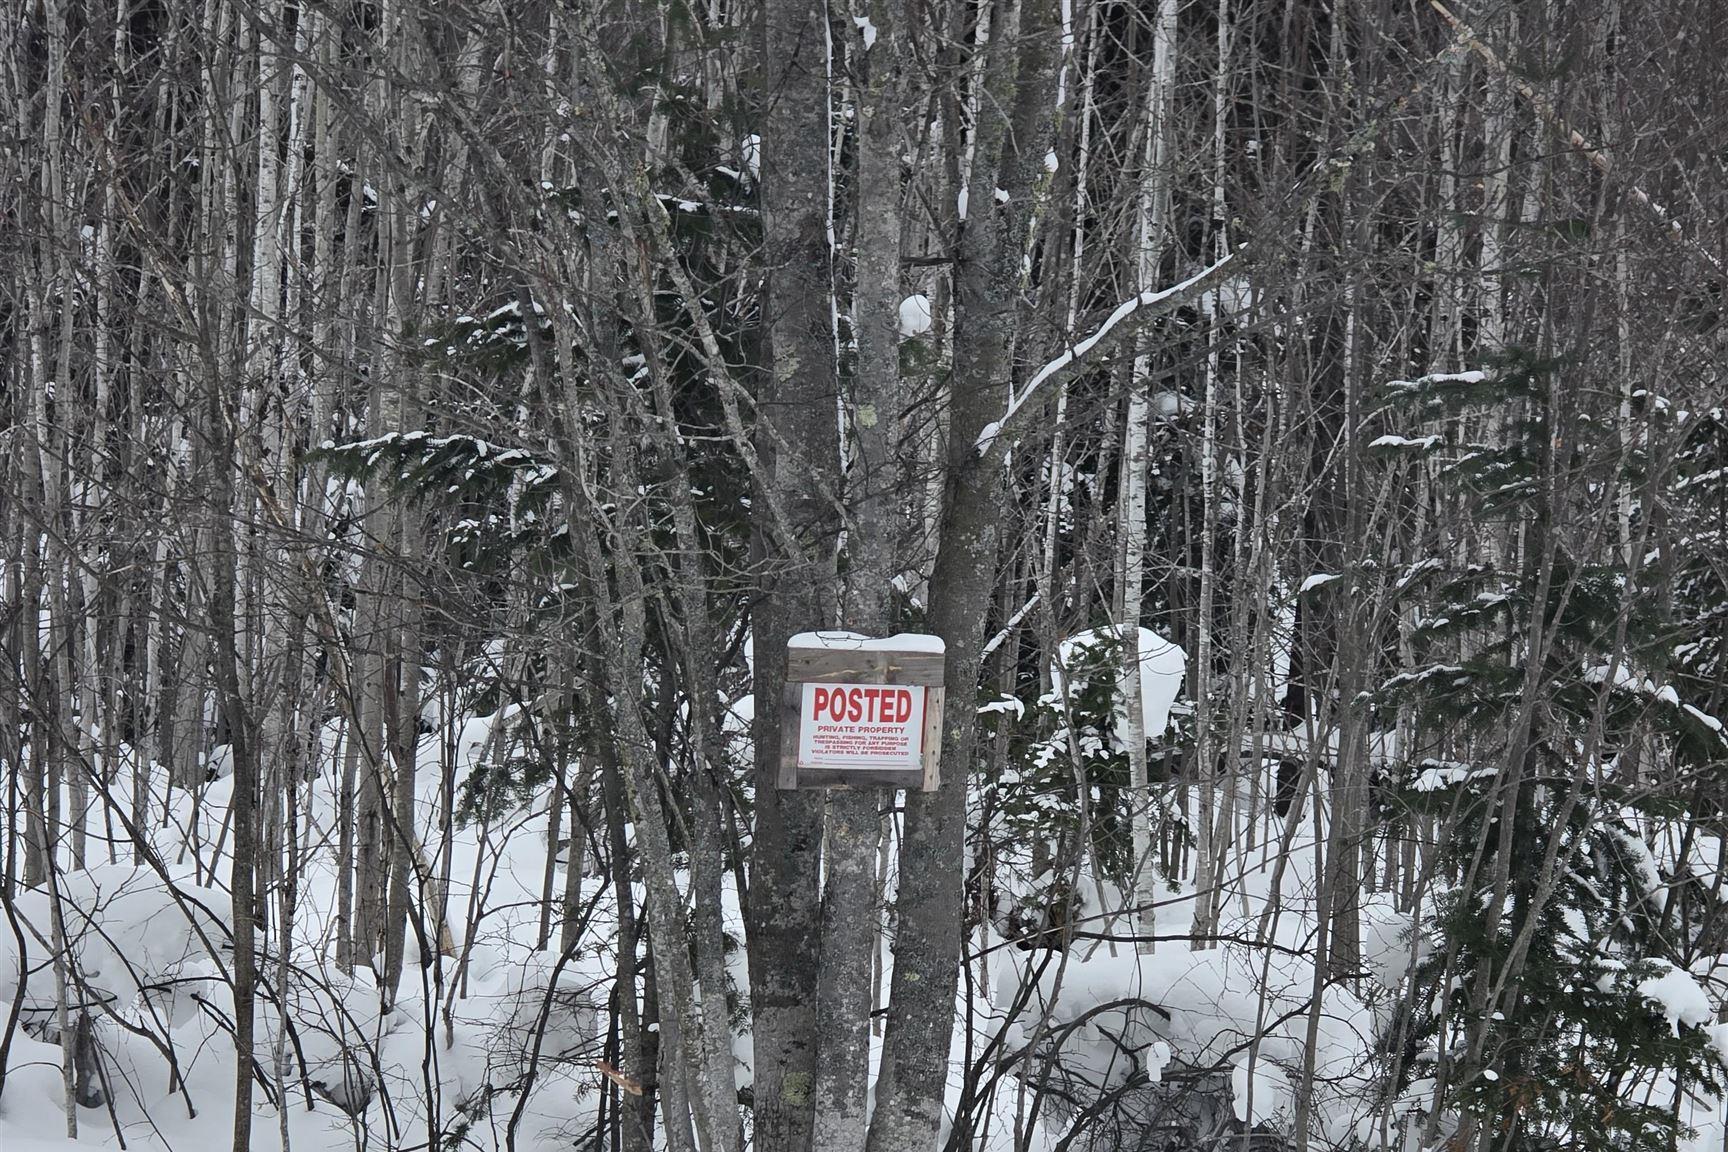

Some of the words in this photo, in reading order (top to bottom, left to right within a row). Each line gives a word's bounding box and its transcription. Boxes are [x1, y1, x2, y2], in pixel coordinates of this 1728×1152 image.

[813, 687, 912, 723] POSTED
[817, 725, 855, 733] PRIVATE
[857, 726, 905, 734] PROPERTY
